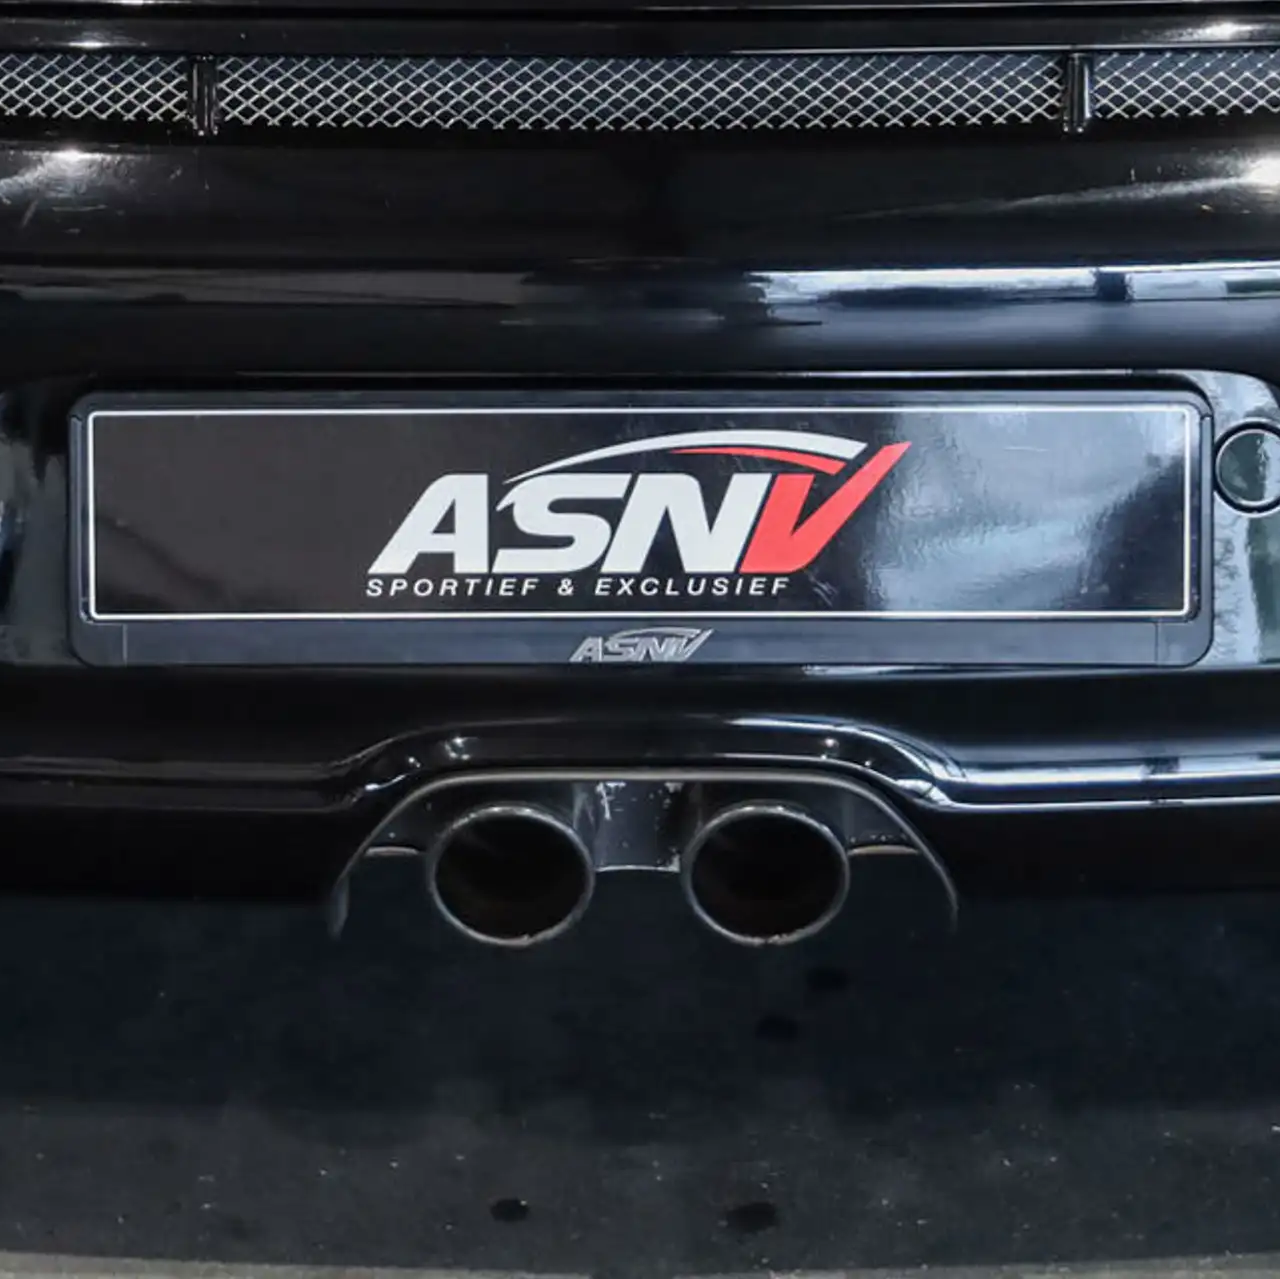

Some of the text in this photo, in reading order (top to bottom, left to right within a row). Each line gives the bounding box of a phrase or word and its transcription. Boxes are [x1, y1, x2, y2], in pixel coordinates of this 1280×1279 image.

[368, 432, 912, 574] ASNV
[366, 577, 790, 597] SPORTIEF & EXCLUSIEF
